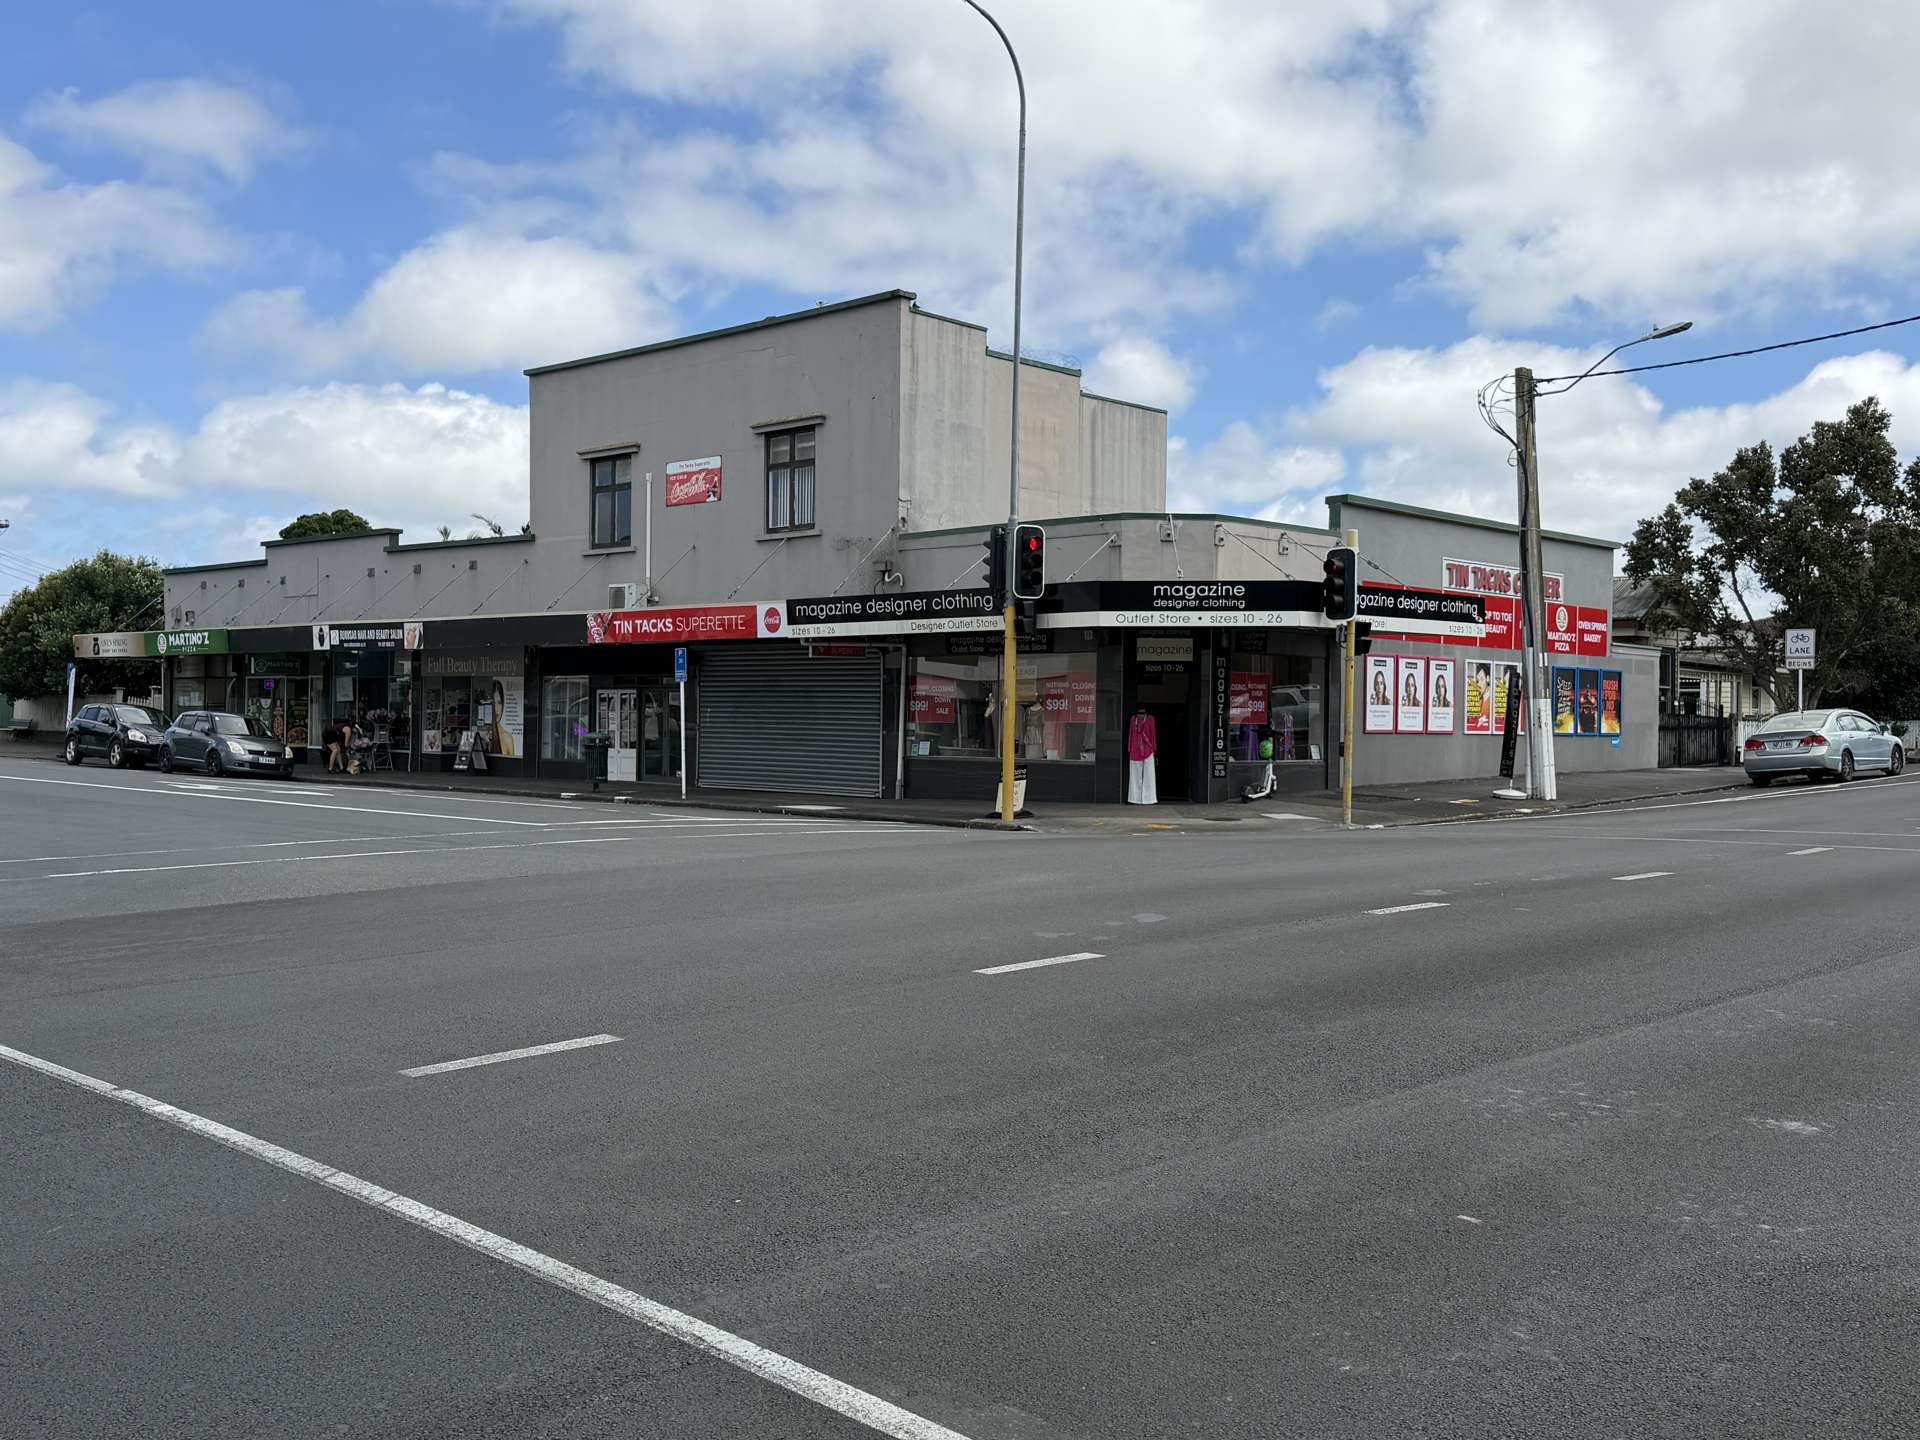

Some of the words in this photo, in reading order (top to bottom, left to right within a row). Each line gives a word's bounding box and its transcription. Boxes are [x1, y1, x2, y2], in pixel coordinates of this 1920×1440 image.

[1446, 563, 1469, 588] TIN
[1471, 566, 1511, 593] TACKS
[1154, 583, 1245, 599] magazine
[796, 602, 862, 618] magazine
[866, 596, 927, 616] designer
[932, 592, 994, 611] clothing
[1154, 599, 1199, 609] designer
[1203, 599, 1245, 609] clothing
[1397, 594, 1439, 614] designer
[1441, 597, 1478, 618] clothing
[1115, 613, 1155, 624] Outlet
[1159, 613, 1190, 624] Store
[1210, 613, 1240, 624] sizes
[1243, 613, 1255, 624] 10
[1267, 613, 1283, 624] 26
[1493, 612, 1500, 620] TO
[1501, 612, 1513, 622] TOE
[613, 620, 633, 635] TIN
[635, 618, 673, 633] TACKS
[676, 614, 746, 632] SUPERETTE
[911, 621, 947, 632] Designer
[948, 619, 973, 630] Outlet
[976, 618, 999, 629] Store
[1448, 624, 1464, 633] sizes
[1485, 623, 1507, 634] BEAUTY
[367, 629, 376, 640] AND
[791, 626, 810, 636] sizes
[827, 626, 836, 634] 26
[1547, 631, 1576, 642] MARTINO'Z
[168, 630, 209, 647] MARTINO'Z
[1583, 633, 1602, 643] BAKERY
[1137, 645, 1192, 657] magazine
[1554, 642, 1570, 651] PIZZA
[1789, 646, 1811, 655] LANE
[427, 656, 446, 673] Full
[447, 656, 478, 675] Beauty
[1787, 660, 1812, 668] BEGINS
[934, 696, 952, 704] DOWN
[1046, 698, 1069, 711] $99!
[910, 700, 929, 712] $99!
[936, 707, 949, 715] SALE
[1247, 700, 1266, 713] $99!
